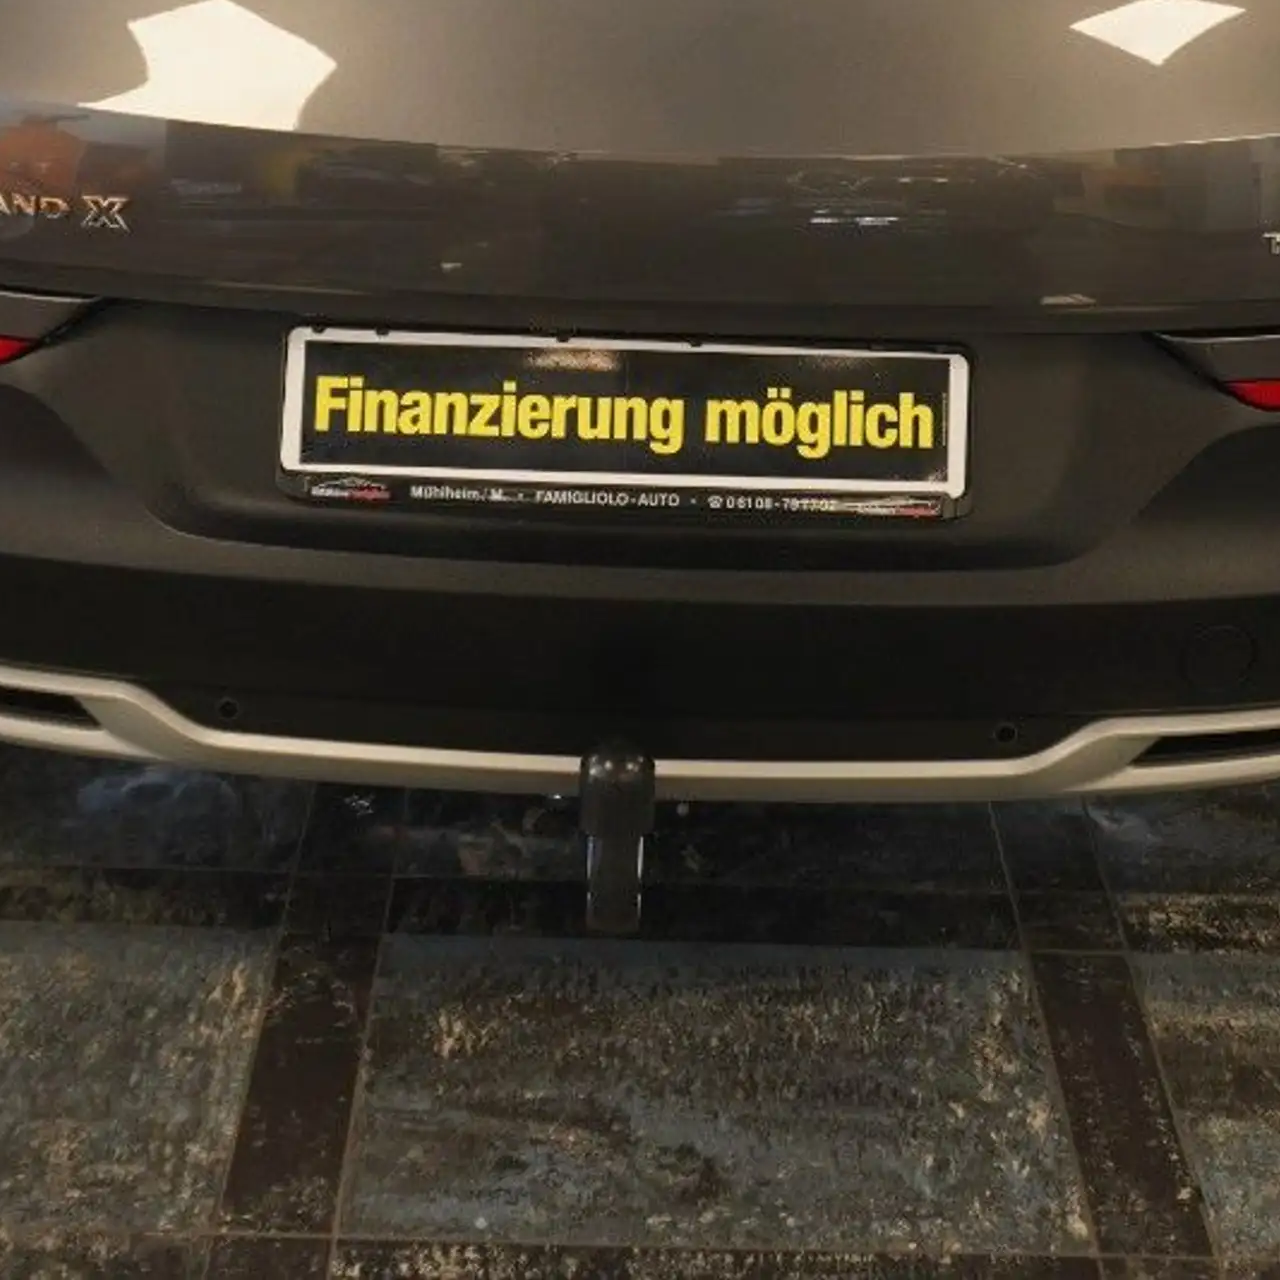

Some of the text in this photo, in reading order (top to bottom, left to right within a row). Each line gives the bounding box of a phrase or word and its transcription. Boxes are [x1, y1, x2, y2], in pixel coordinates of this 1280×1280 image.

[80, 194, 131, 233] X
[315, 375, 685, 455] Finanzierung
[705, 387, 934, 459] möglich
